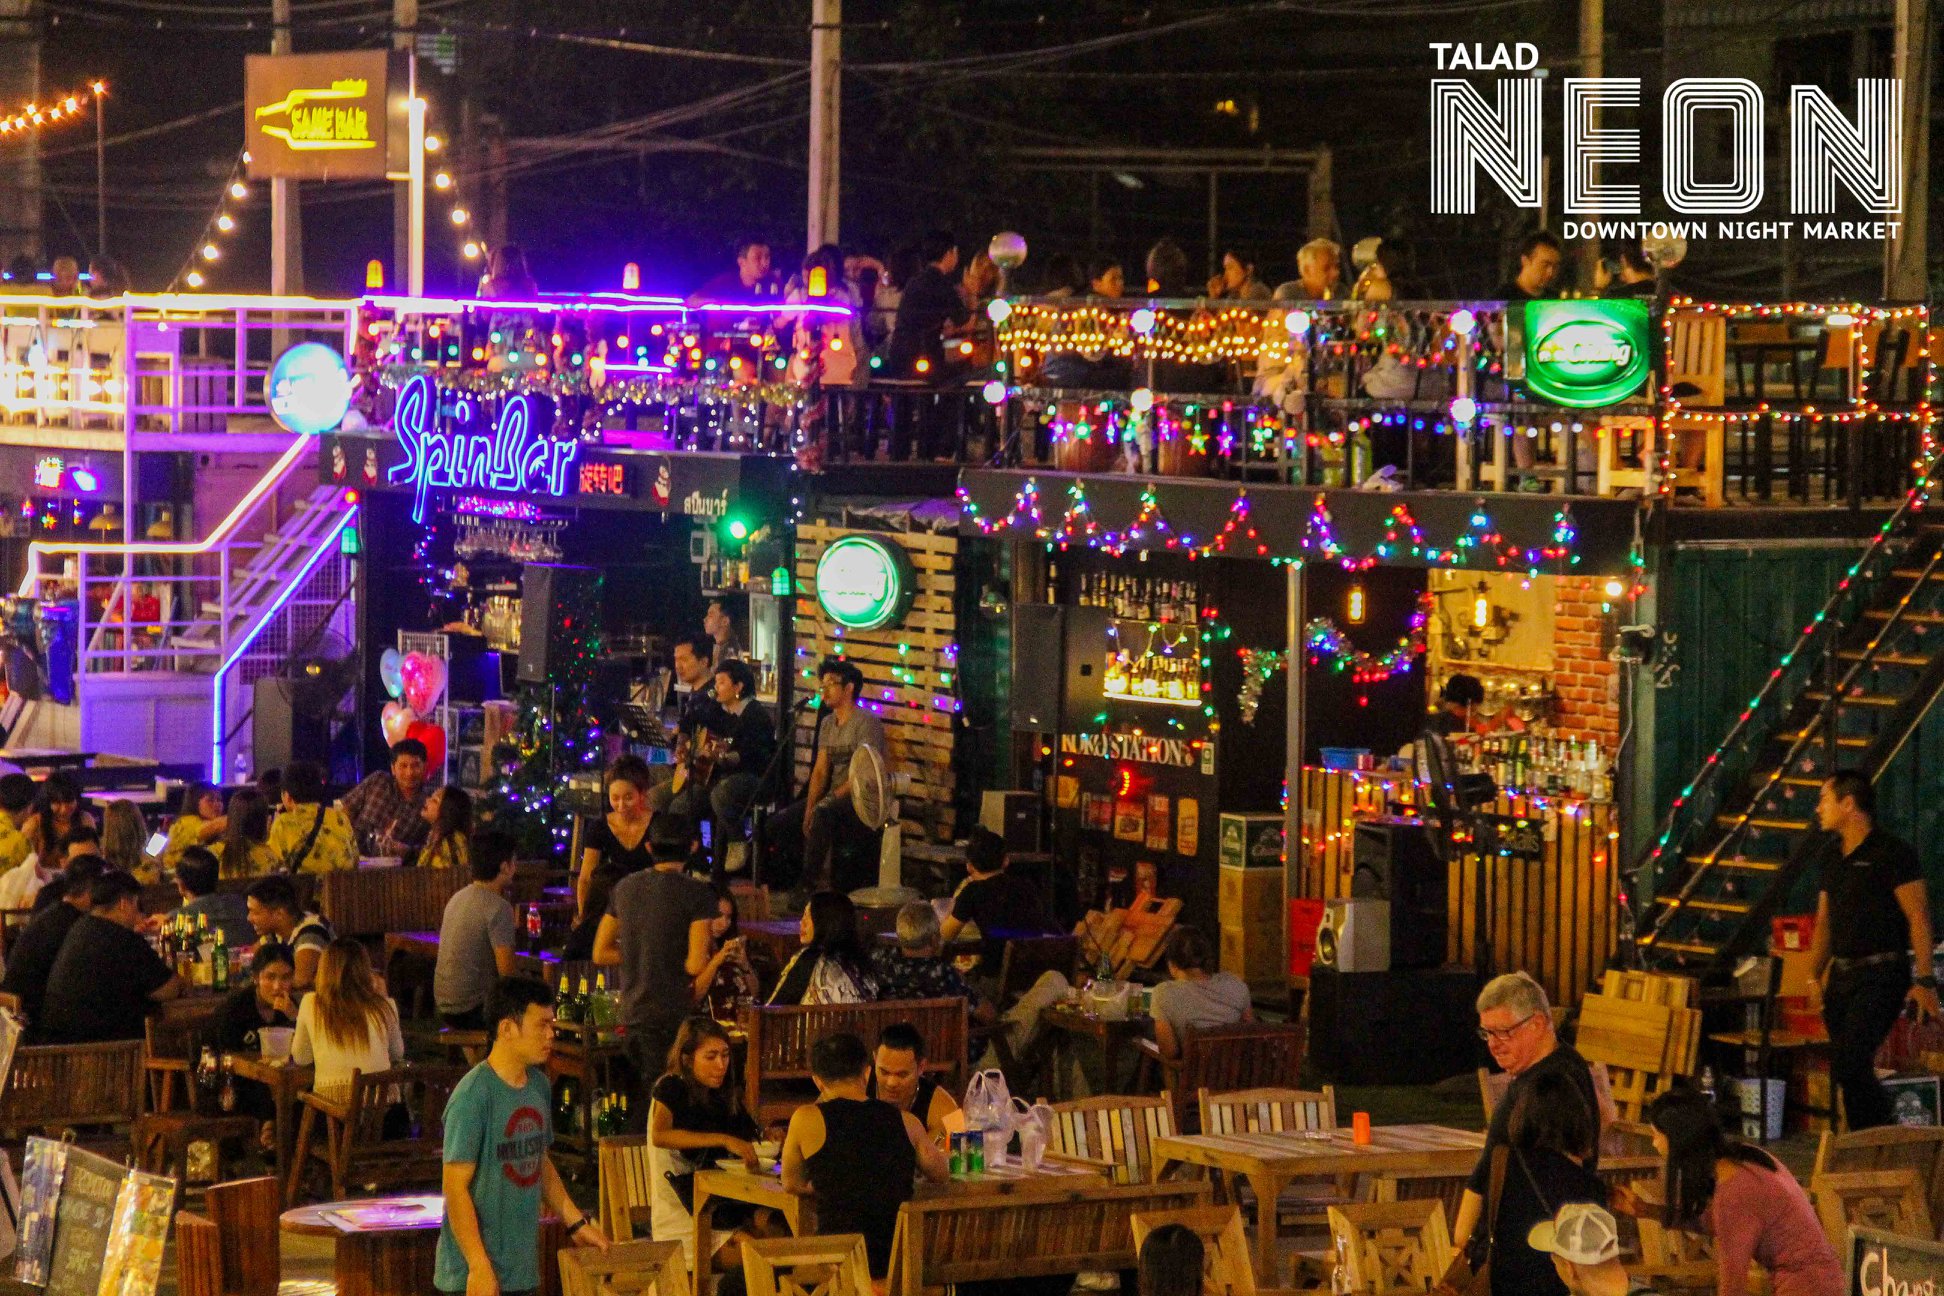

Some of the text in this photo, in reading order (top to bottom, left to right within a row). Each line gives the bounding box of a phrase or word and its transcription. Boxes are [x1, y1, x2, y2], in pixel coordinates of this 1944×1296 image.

[291, 106, 369, 139] SAME BAR
[1110, 733, 1184, 767] STATION
